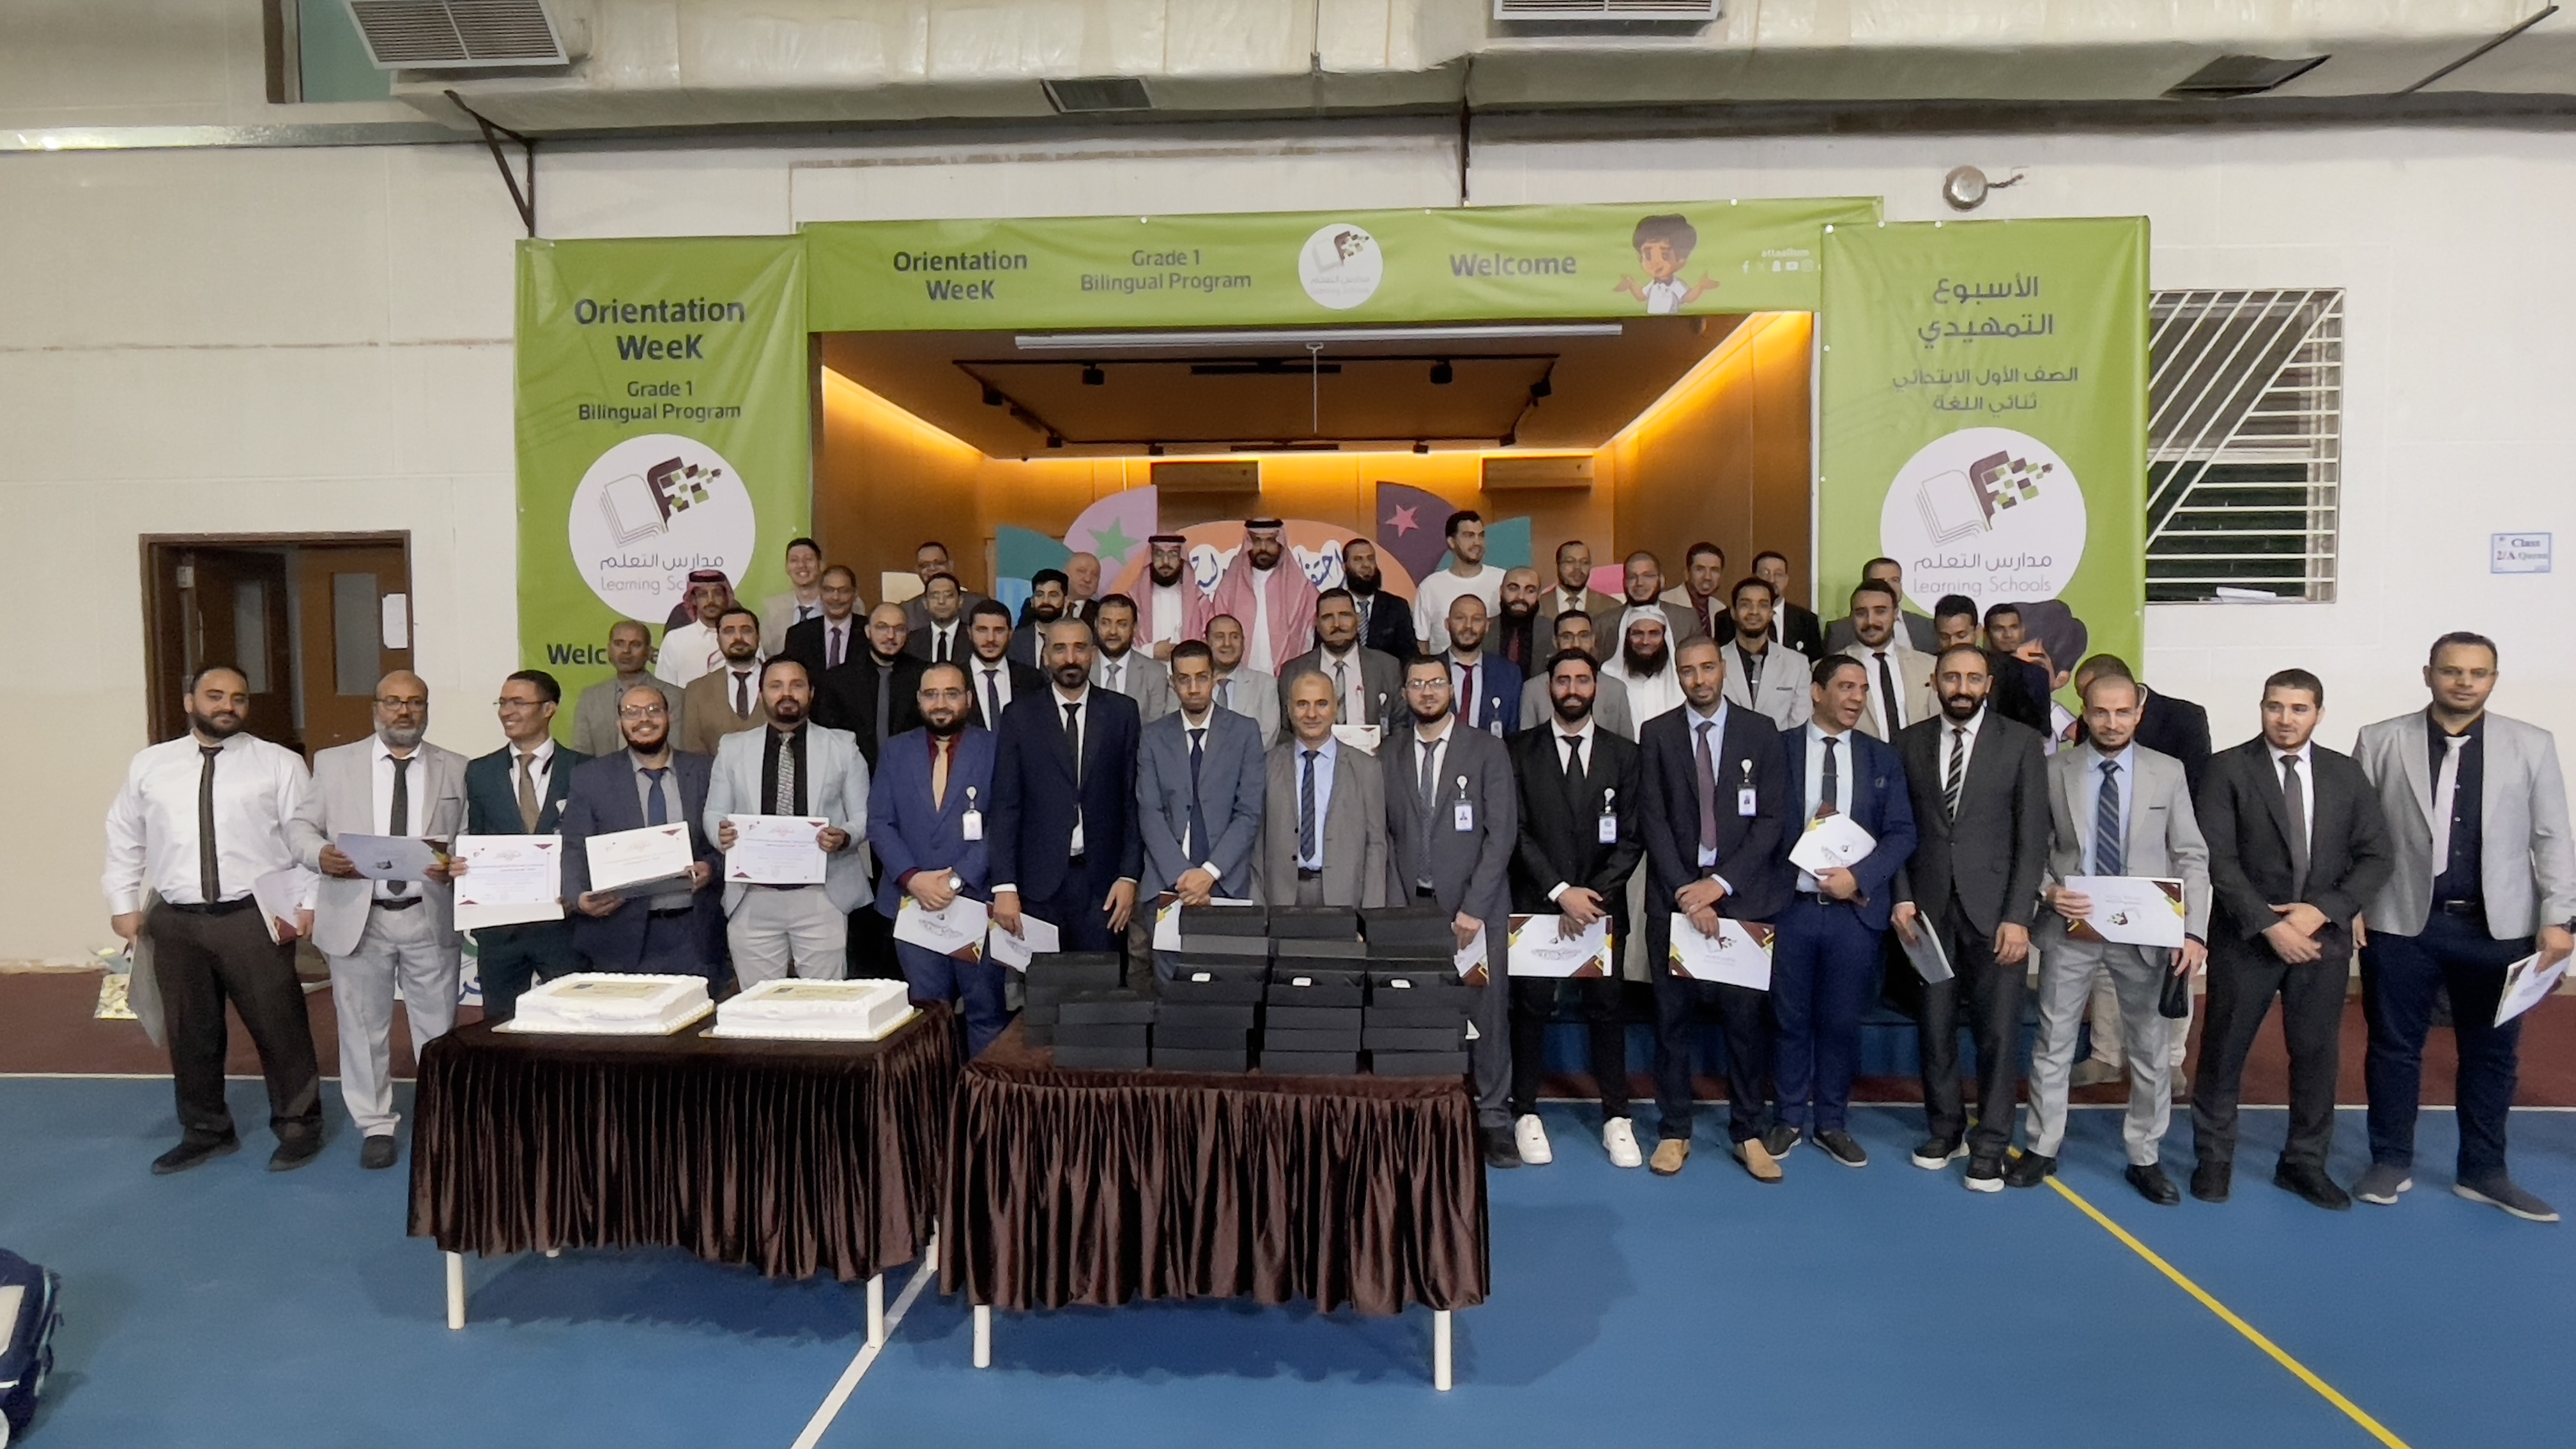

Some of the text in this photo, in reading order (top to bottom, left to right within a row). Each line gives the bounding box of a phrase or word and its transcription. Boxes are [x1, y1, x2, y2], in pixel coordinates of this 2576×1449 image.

[894, 250, 1028, 272] Orientation
[1131, 249, 1200, 266] Grade 1
[1450, 253, 1577, 277] Welcome
[1081, 272, 1252, 295] Bilingual Program
[1933, 272, 2039, 305] الأسبوع
[574, 296, 746, 324] Orientation
[1918, 314, 2054, 349] التمهيدي
[1975, 366, 2019, 386] الأول
[2024, 367, 2078, 383] الصف
[627, 380, 693, 397] Grade 1
[579, 403, 740, 424] Bilingual Program
[1933, 392, 2037, 418] ثنائي اللغة
[600, 553, 724, 571] مدارس التعلم
[1914, 552, 2052, 572] مدارس التعلم
[601, 576, 661, 595] Learning
[1913, 574, 2051, 597] Learning Schools
